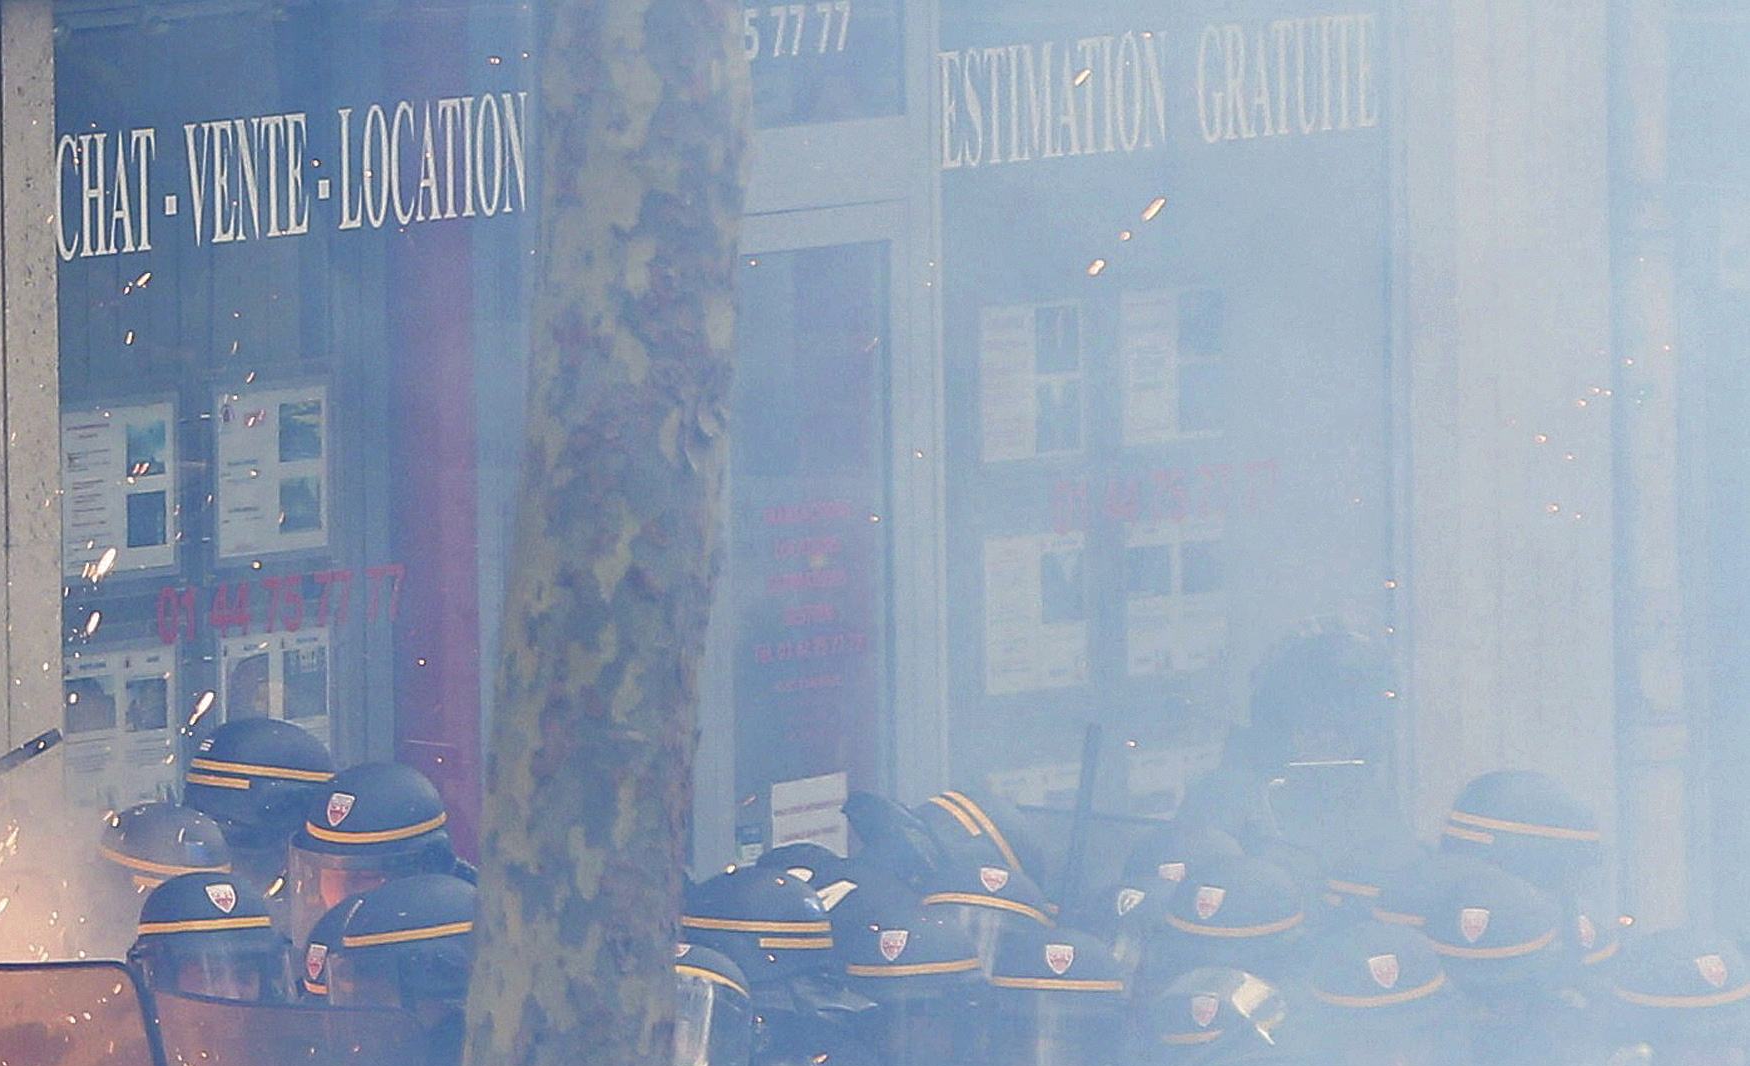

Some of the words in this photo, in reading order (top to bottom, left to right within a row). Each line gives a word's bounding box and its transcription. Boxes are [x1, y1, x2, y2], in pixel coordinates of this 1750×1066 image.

[770, 5, 806, 57] 77
[816, 1, 850, 53] 77
[937, 29, 1167, 169] ESTIMATION
[1196, 13, 1378, 143] GRATUITE
[56, 128, 156, 261] CHAT
[184, 112, 309, 247] VENTE
[338, 91, 528, 231] LOCATION
[156, 586, 197, 645] 01
[210, 579, 251, 639] 44
[261, 574, 304, 633] 75
[313, 569, 353, 627] 77
[365, 563, 405, 623] 77
